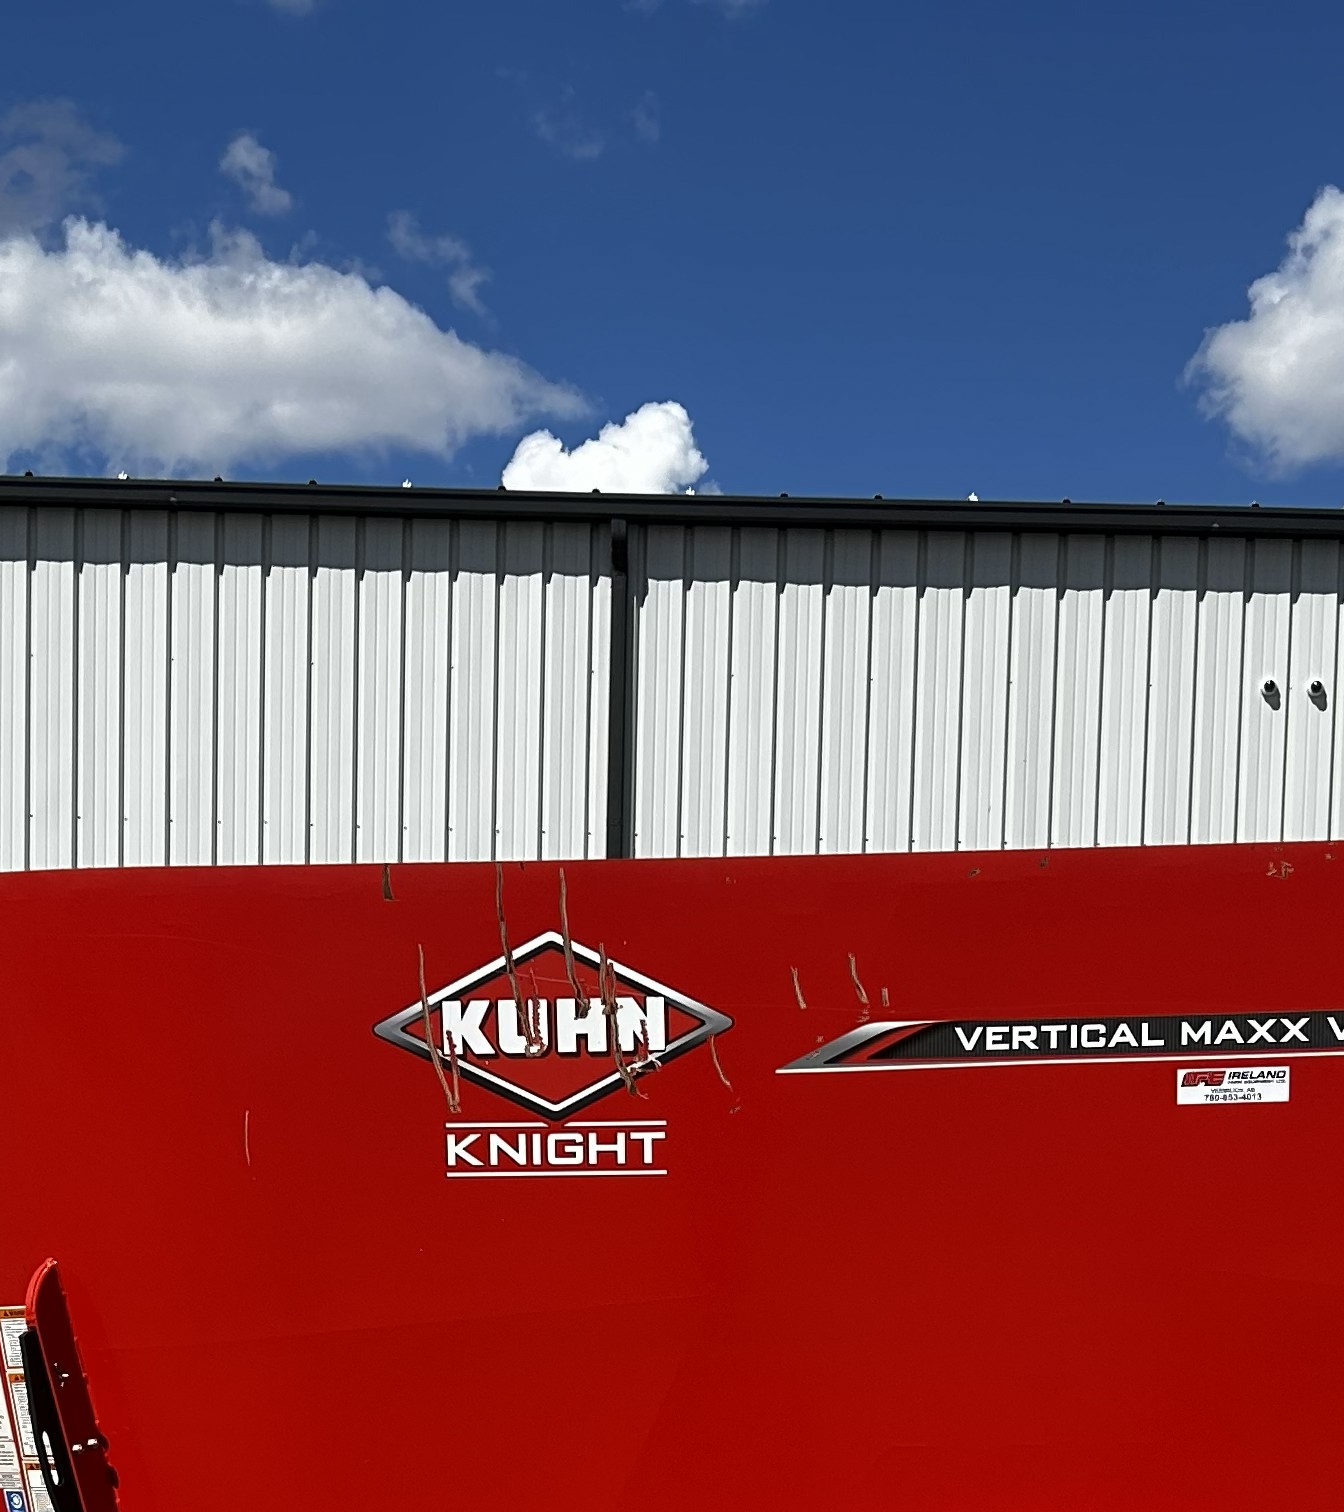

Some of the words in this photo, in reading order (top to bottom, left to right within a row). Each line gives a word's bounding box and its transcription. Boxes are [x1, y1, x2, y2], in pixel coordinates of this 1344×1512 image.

[441, 996, 665, 1055] KUHN
[955, 1023, 1165, 1052] VERTICAL
[1180, 1017, 1311, 1045] MAXX
[1228, 1070, 1286, 1080] IRELAND
[447, 1132, 666, 1166] KNIGHT
